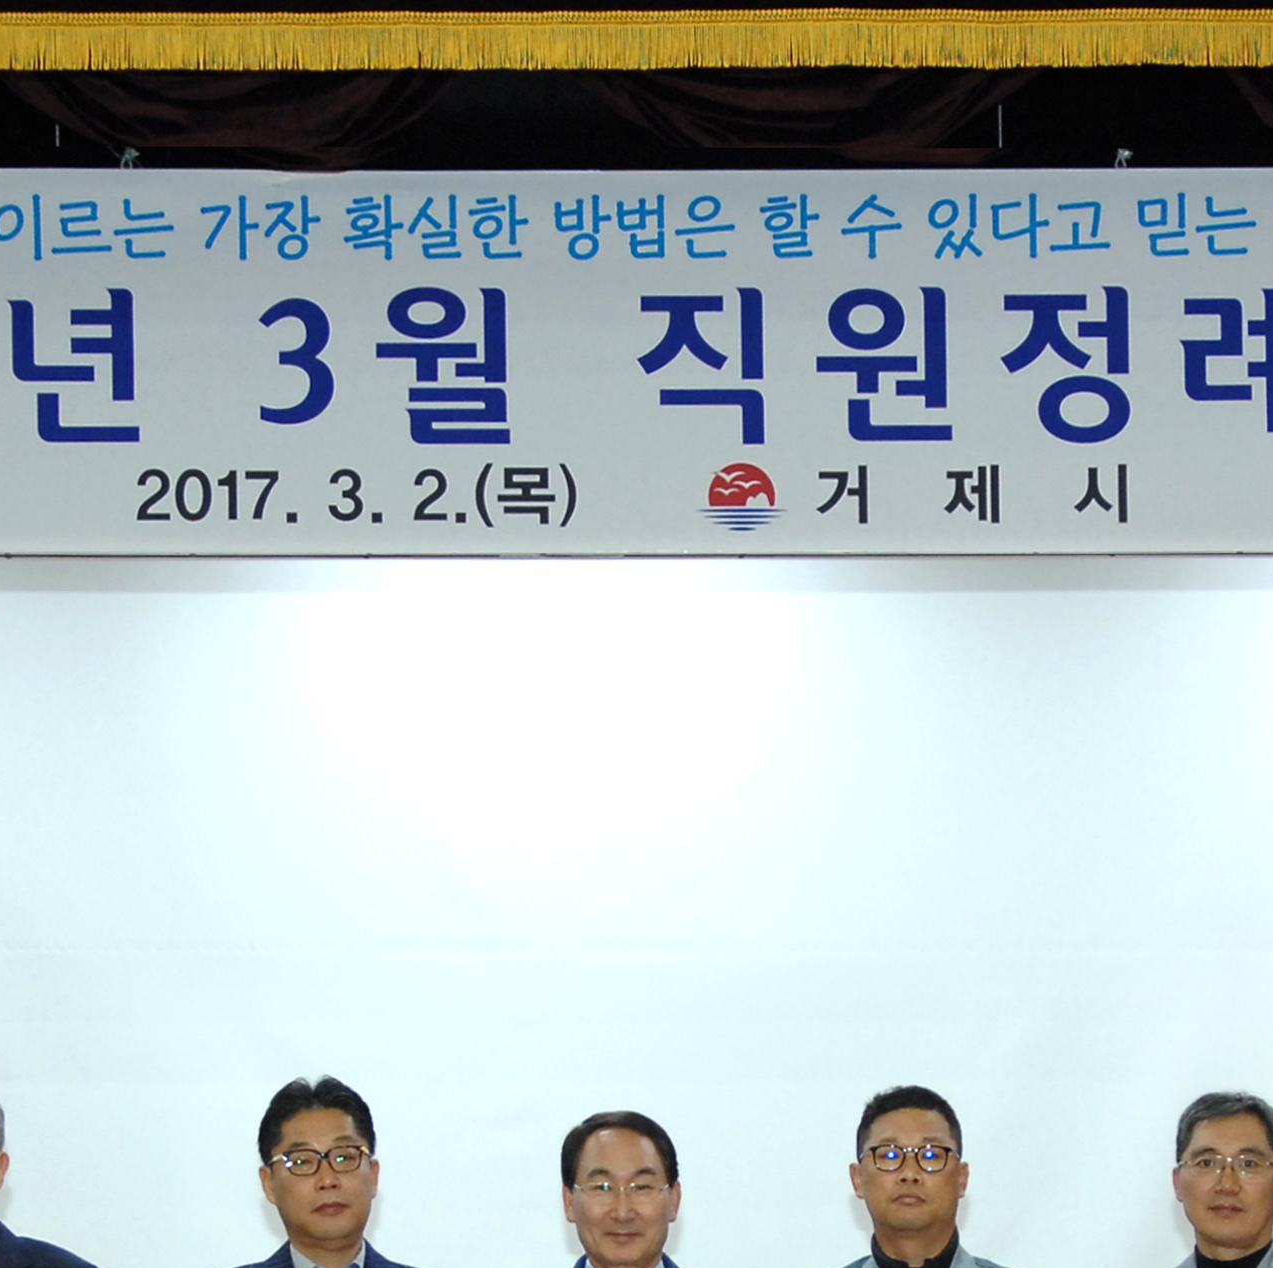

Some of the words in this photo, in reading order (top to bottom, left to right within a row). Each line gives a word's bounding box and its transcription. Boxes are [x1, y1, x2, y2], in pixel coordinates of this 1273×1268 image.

[199, 194, 323, 262] 가장
[343, 193, 532, 262] 확실한
[553, 193, 737, 262] 방법은
[759, 193, 823, 260] 할
[841, 193, 904, 261] 수
[927, 192, 1114, 261] 있다고
[1137, 191, 1259, 258] 믿는
[259, 286, 512, 446] 3월
[136, 468, 300, 524] 2017.
[328, 468, 384, 525] 3.
[413, 464, 579, 529] 2.(목)
